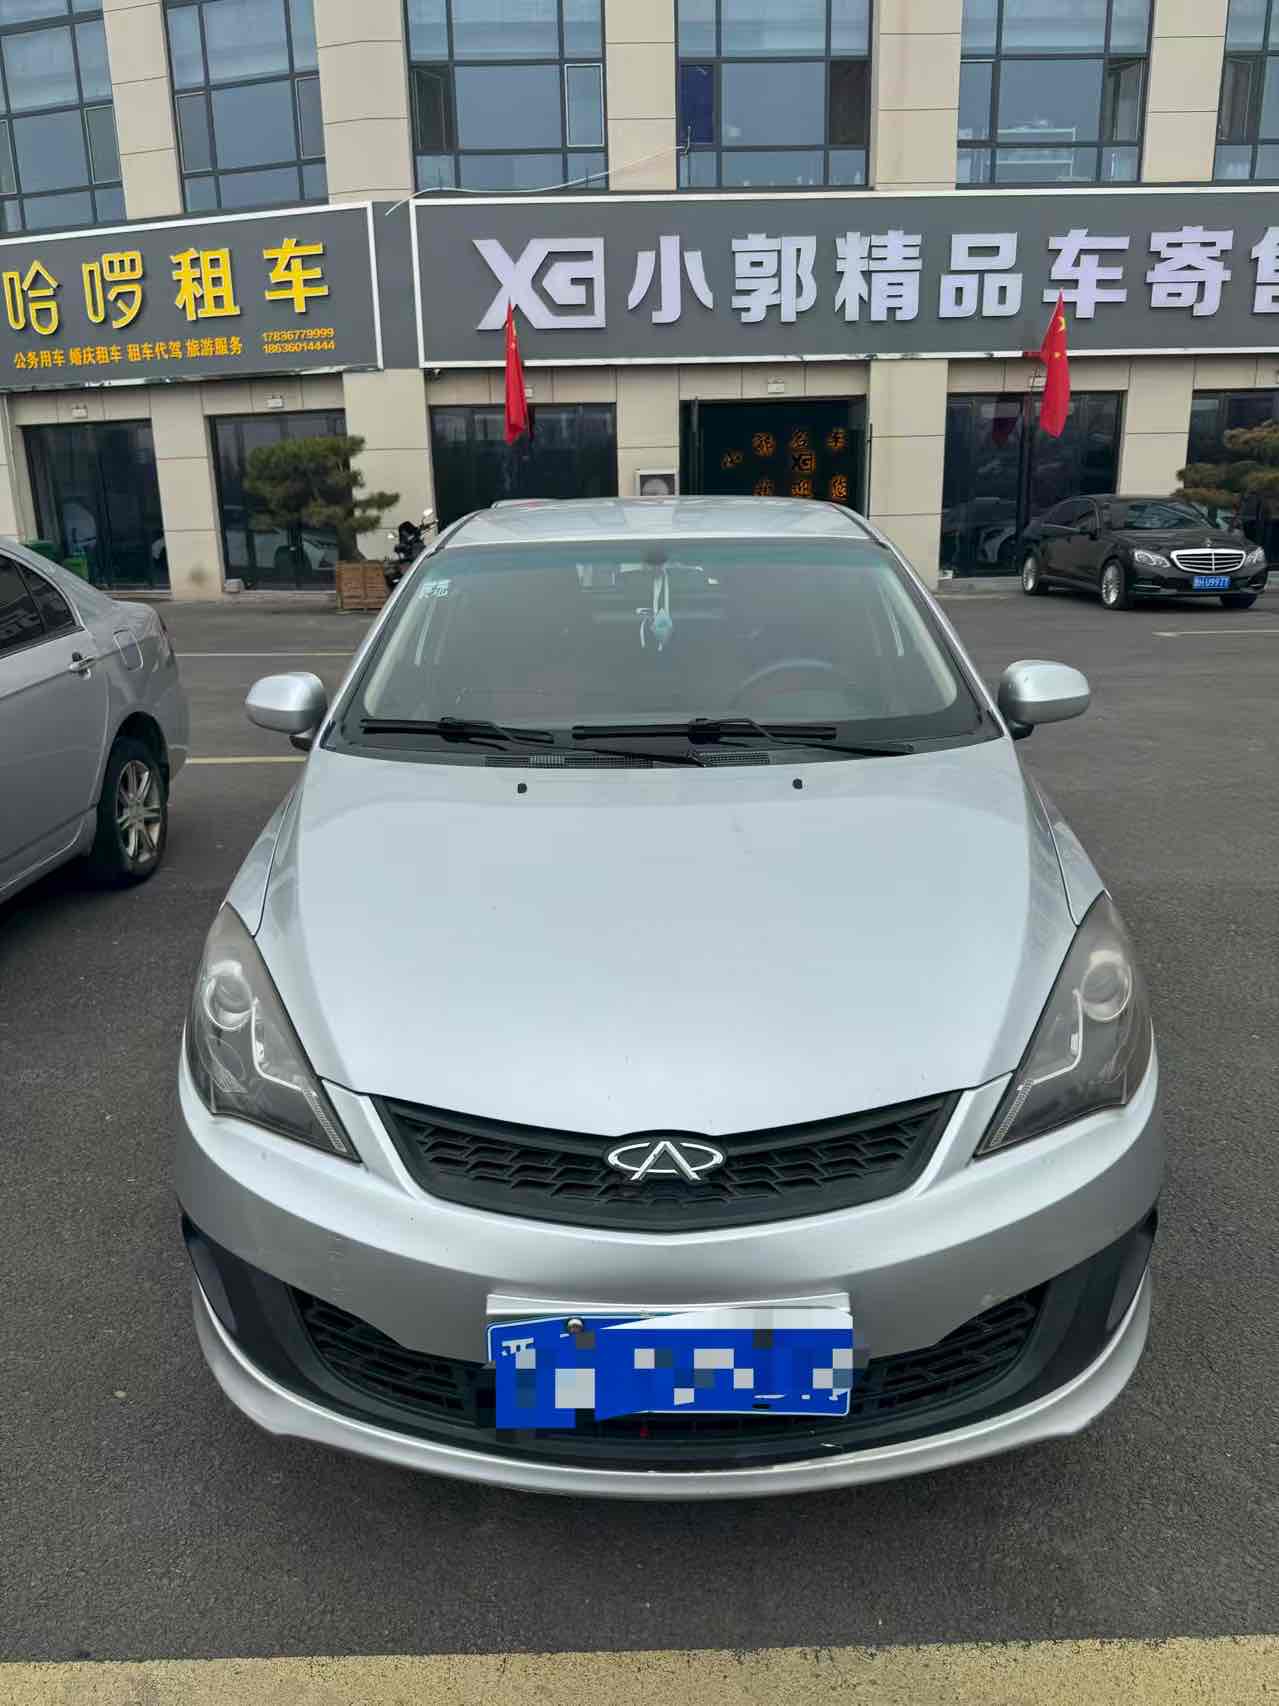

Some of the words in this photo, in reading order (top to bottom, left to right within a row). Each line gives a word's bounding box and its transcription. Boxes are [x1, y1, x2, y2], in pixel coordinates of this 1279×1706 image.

[2, 238, 329, 336] 哈啰租车
[472, 236, 606, 331] XG
[14, 349, 65, 369] 公务用车
[69, 344, 123, 366] 婚庆租车
[127, 340, 183, 362] 租车代驾
[186, 335, 243, 358] 旅游服务
